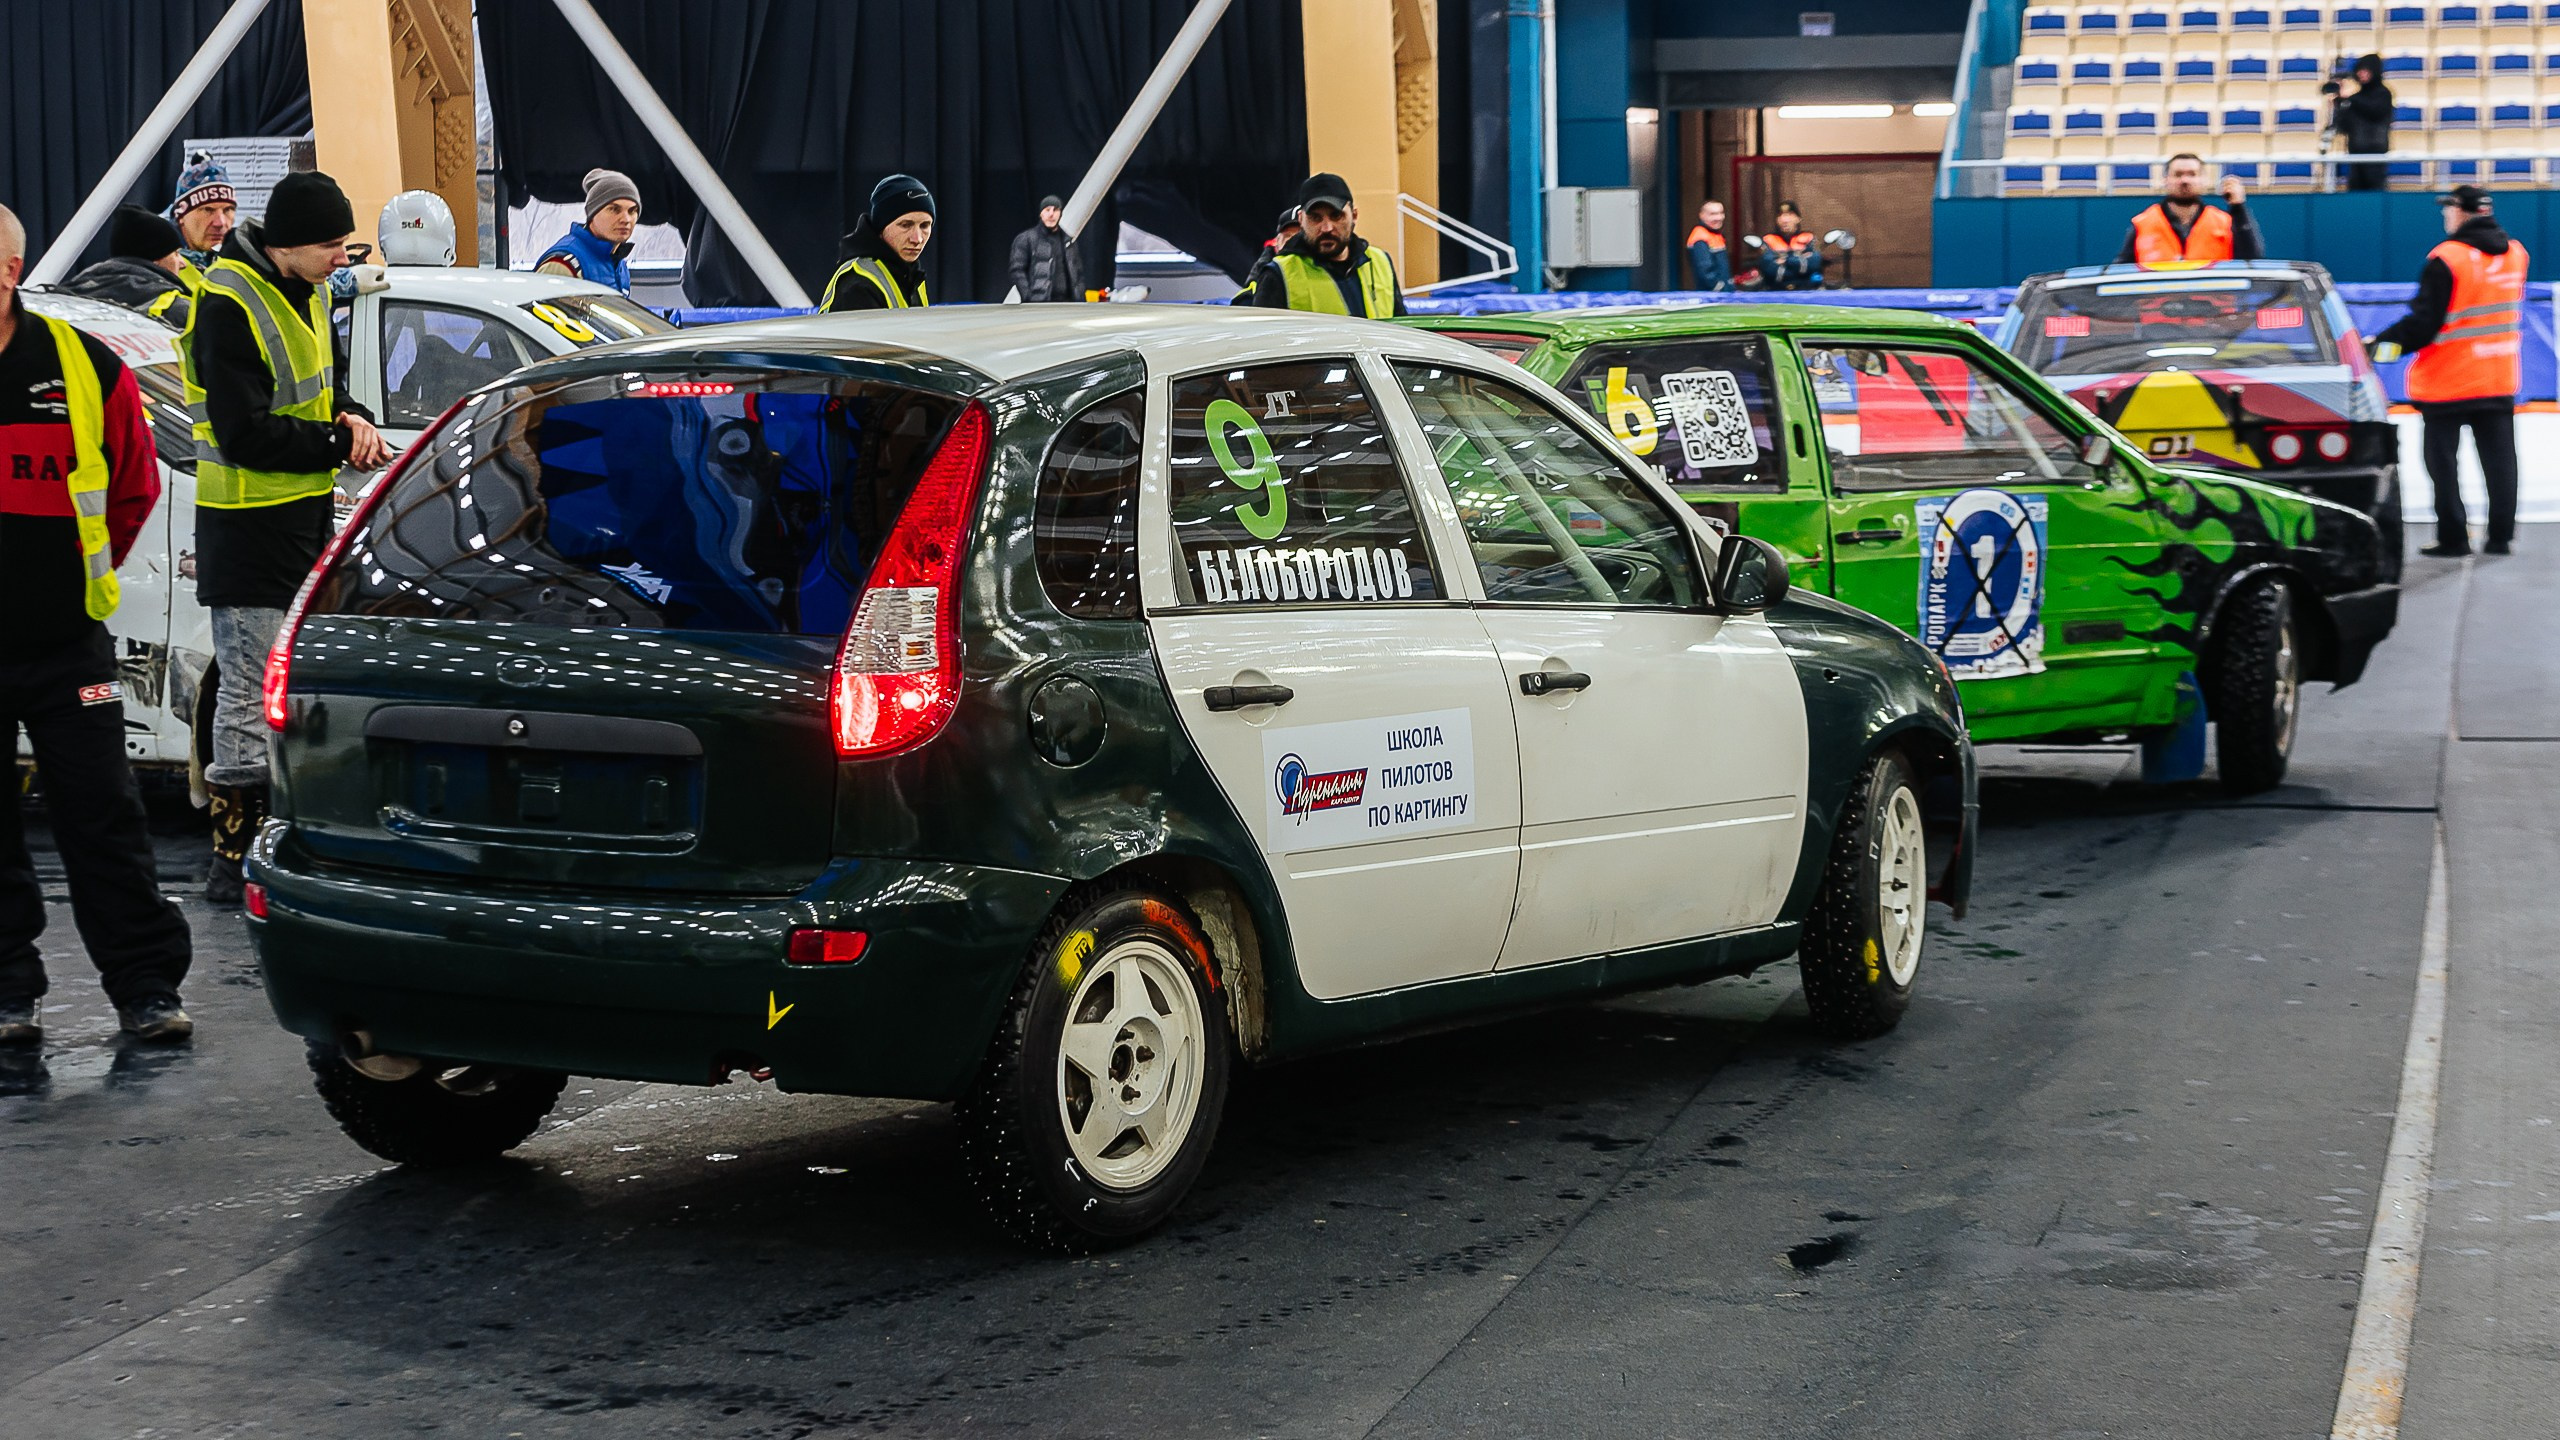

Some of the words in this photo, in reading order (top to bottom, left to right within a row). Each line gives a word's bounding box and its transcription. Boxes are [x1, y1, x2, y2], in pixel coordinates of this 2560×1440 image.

[532, 303, 595, 342] 8
[1606, 367, 1658, 456] 6
[1204, 399, 1288, 540] 9
[1198, 547, 1412, 602] БЕЛОБОРОДОВ
[1971, 535, 1995, 619] 1
[1926, 583, 1947, 653] РОПАРК
[1387, 726, 1443, 751] ШКОЛА
[1291, 770, 1363, 826] Адреналин
[1382, 761, 1453, 789] ПИЛОТОВ
[1368, 804, 1390, 827] ПО
[1395, 794, 1468, 824] КАРТИНГУ
